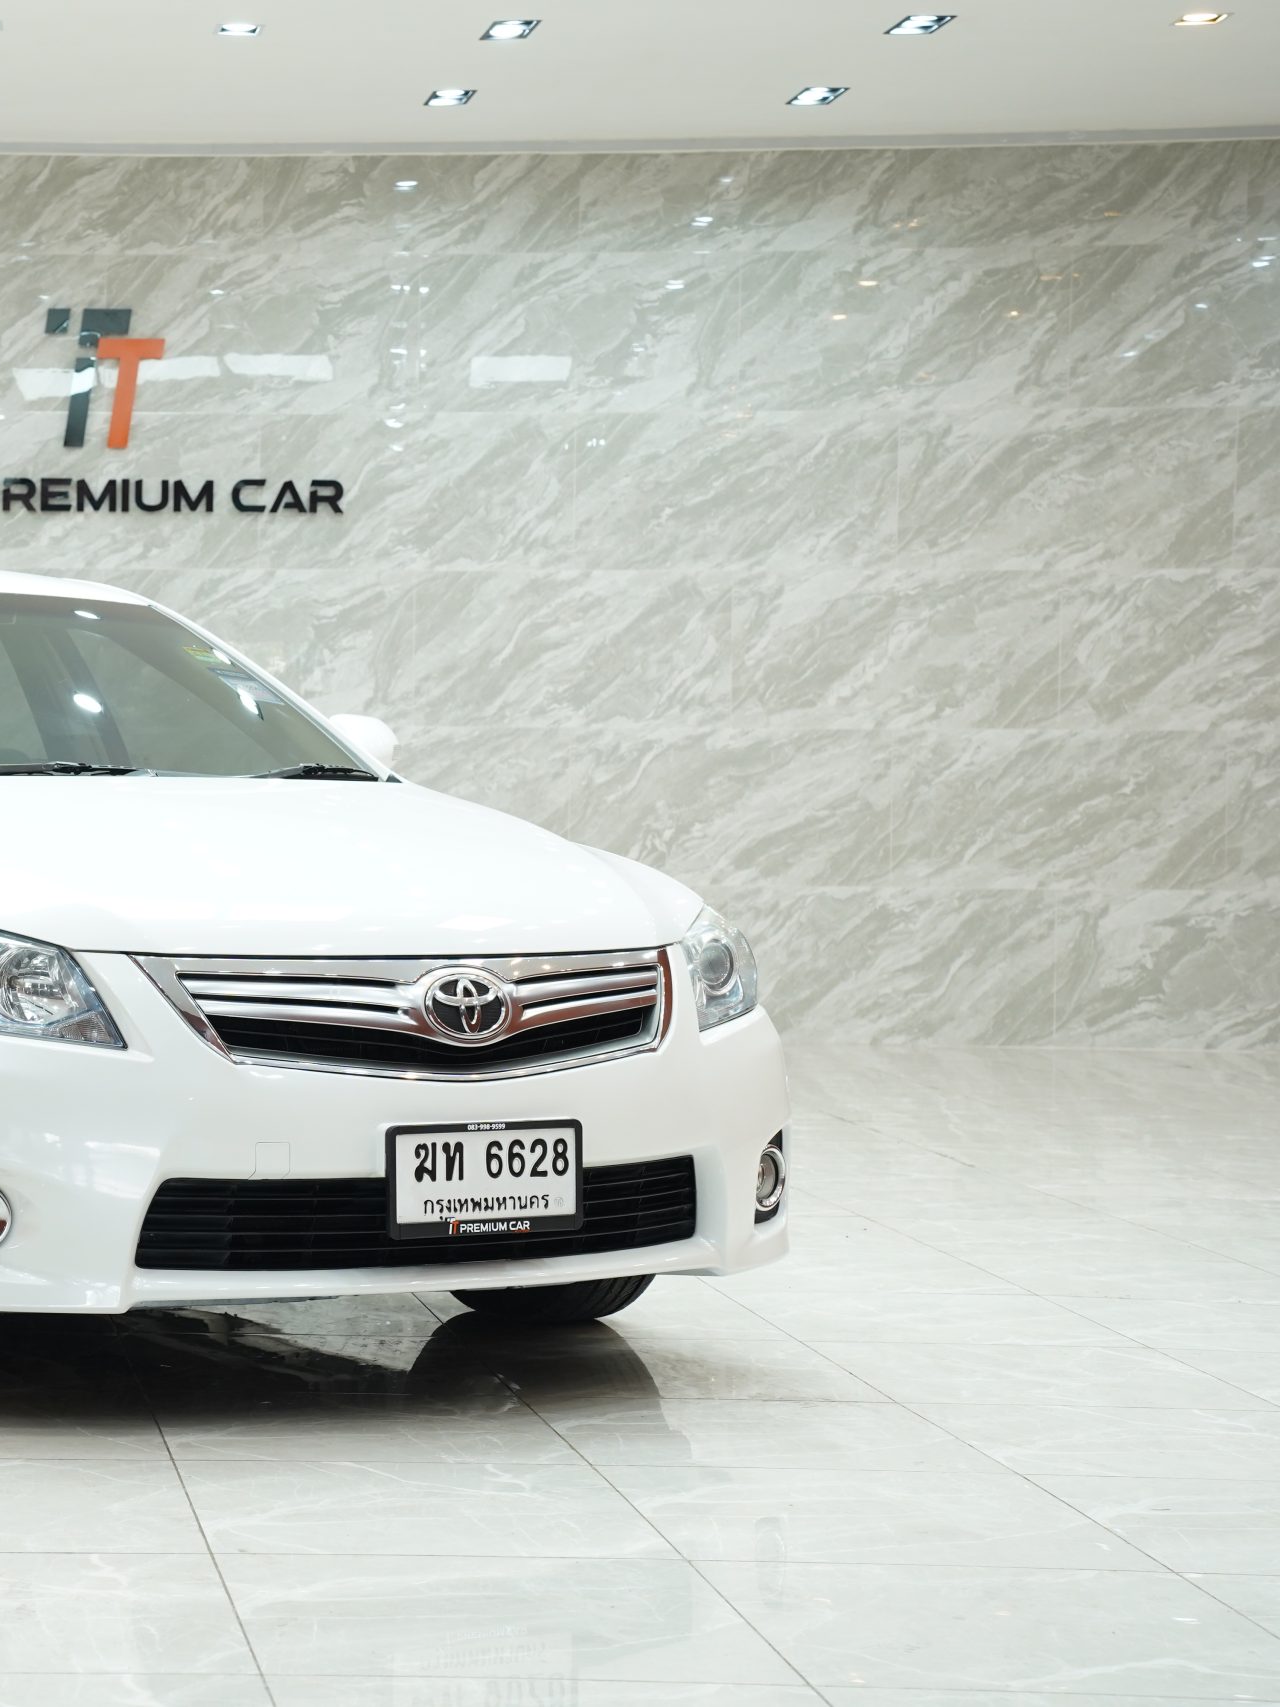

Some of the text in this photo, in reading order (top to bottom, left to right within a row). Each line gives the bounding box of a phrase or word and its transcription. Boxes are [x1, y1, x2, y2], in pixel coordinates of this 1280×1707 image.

[232, 479, 344, 514] CAR
[486, 1138, 569, 1179] 6628
[424, 1194, 549, 1219] กรุงเทพมหานคร
[459, 1222, 507, 1233] PREMIUM
[509, 1221, 530, 1230] CAR
